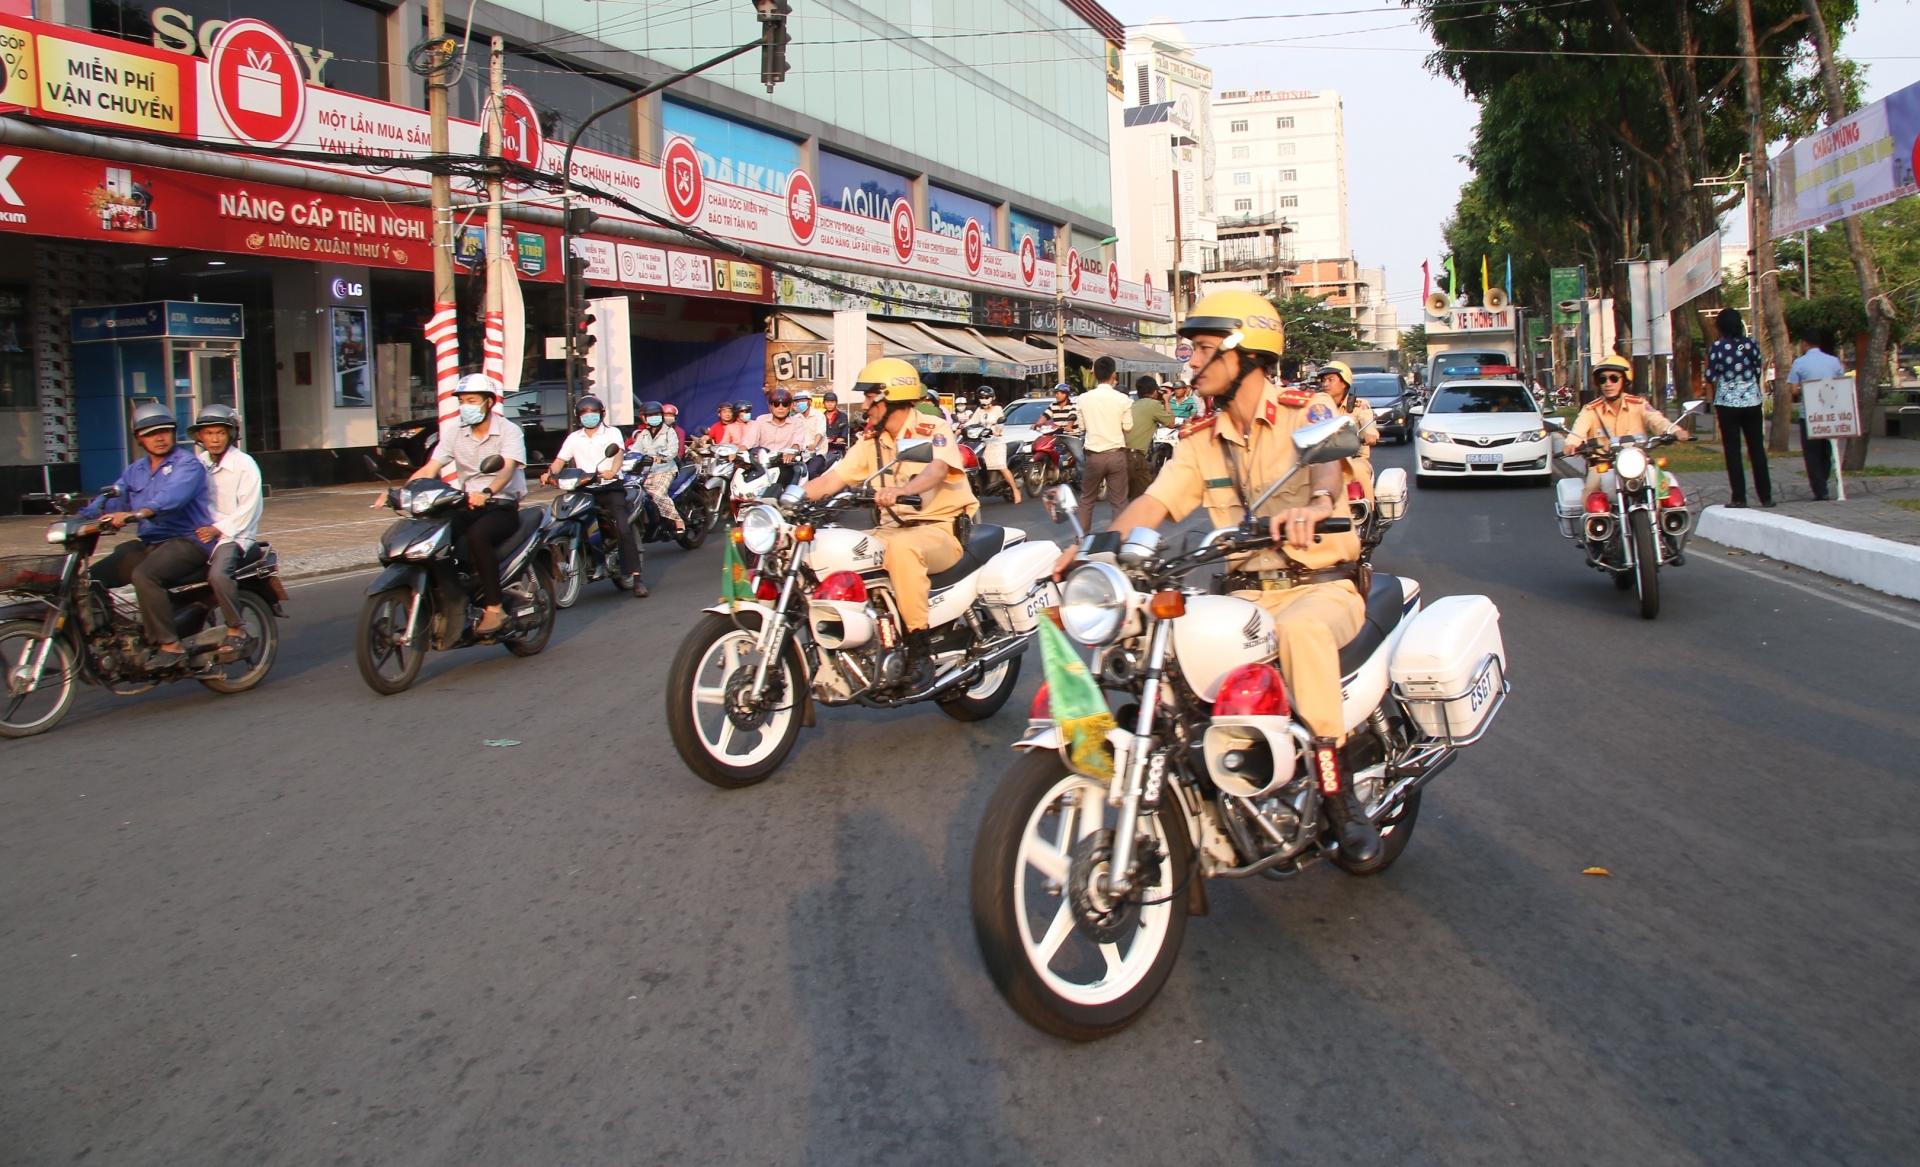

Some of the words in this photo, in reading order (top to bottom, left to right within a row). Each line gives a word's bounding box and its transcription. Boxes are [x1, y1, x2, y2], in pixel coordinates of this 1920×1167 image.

[152, 7, 334, 87] SOY
[67, 57, 118, 85] MIỄN
[124, 71, 155, 92] PHÍ
[47, 82, 91, 107] VẬN
[100, 93, 174, 122] CHUYỂN
[319, 109, 347, 131] MỘT
[351, 112, 374, 135] LẦN
[378, 123, 404, 141] MUA
[407, 125, 431, 146] SẮM
[549, 156, 578, 176] HÀG
[581, 164, 611, 184] CHÍNH
[614, 171, 640, 189] HÃNG
[220, 191, 285, 222] NÂNG
[291, 198, 334, 228] CẤP
[338, 208, 375, 237] TIỆN
[381, 216, 426, 239] NGHI
[708, 193, 727, 210] CHĂM
[729, 197, 743, 211] SÓC
[743, 199, 757, 214] MIỄN
[758, 204, 769, 216] PHÍ
[708, 212, 722, 225] BẢO
[723, 215, 733, 227] TRÌ
[734, 217, 746, 230] TẬN
[747, 219, 758, 231] NƠI
[269, 231, 311, 250] MỪNG
[314, 237, 350, 255] XUÂN
[354, 243, 380, 258] NHƯ
[381, 242, 390, 259] Ý
[821, 235, 835, 246] GIAO
[348, 283, 363, 296] LG
[171, 312, 188, 323] ATM
[193, 316, 231, 326] EXIMBANK
[1457, 312, 1468, 330] XE
[1470, 308, 1493, 329] THÔNG
[890, 376, 917, 386] CSGT
[1808, 411, 1824, 423] CẤM
[1826, 413, 1836, 422] XE
[1837, 411, 1853, 421] VÀO
[1812, 424, 1831, 434] CÔNG
[1834, 423, 1852, 433] VIÊN
[1026, 592, 1051, 618] CSGT
[1470, 671, 1492, 712] CSGT
